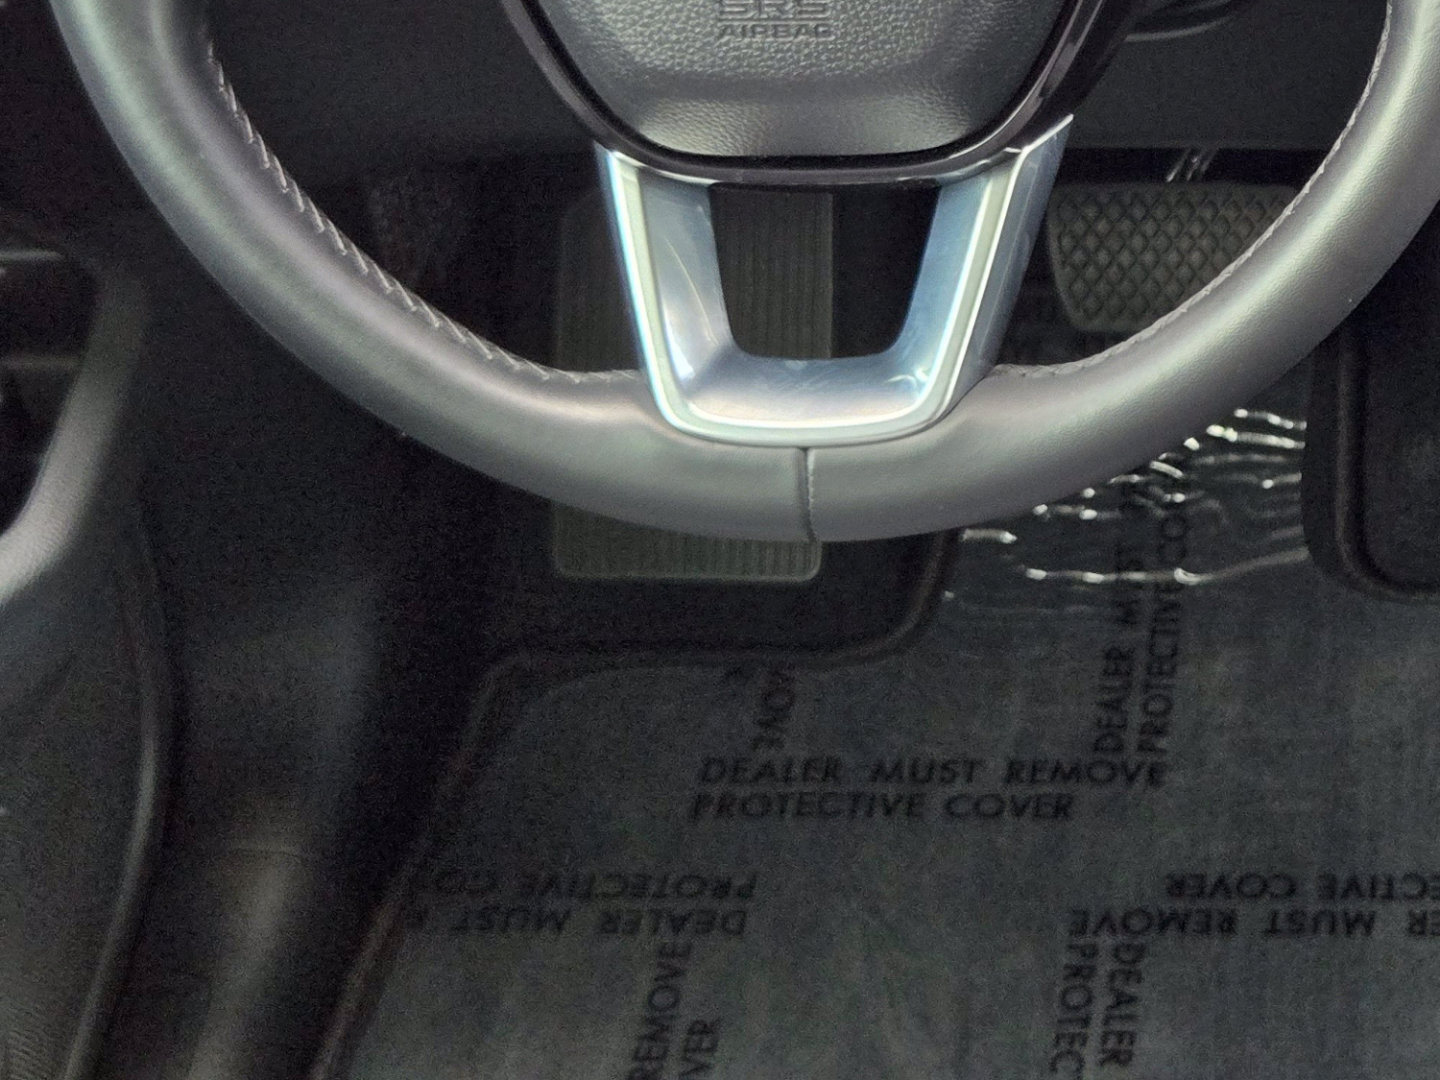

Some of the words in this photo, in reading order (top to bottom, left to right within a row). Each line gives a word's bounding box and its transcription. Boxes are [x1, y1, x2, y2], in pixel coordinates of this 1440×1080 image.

[718, 23, 836, 41] AIRBAG
[699, 756, 843, 786] DEALER
[869, 756, 986, 785] MUST
[1002, 756, 1170, 788] REMOVE
[688, 791, 928, 821] PROTECTIVE
[942, 790, 1076, 820] COVER
[1164, 871, 1298, 900] COVER
[1066, 907, 1239, 938] REMOVE
[1260, 908, 1378, 938] MUST
[1050, 943, 1100, 1080] PROTEC
[1099, 942, 1148, 1067] DEALER
[679, 1017, 723, 1080] VER
